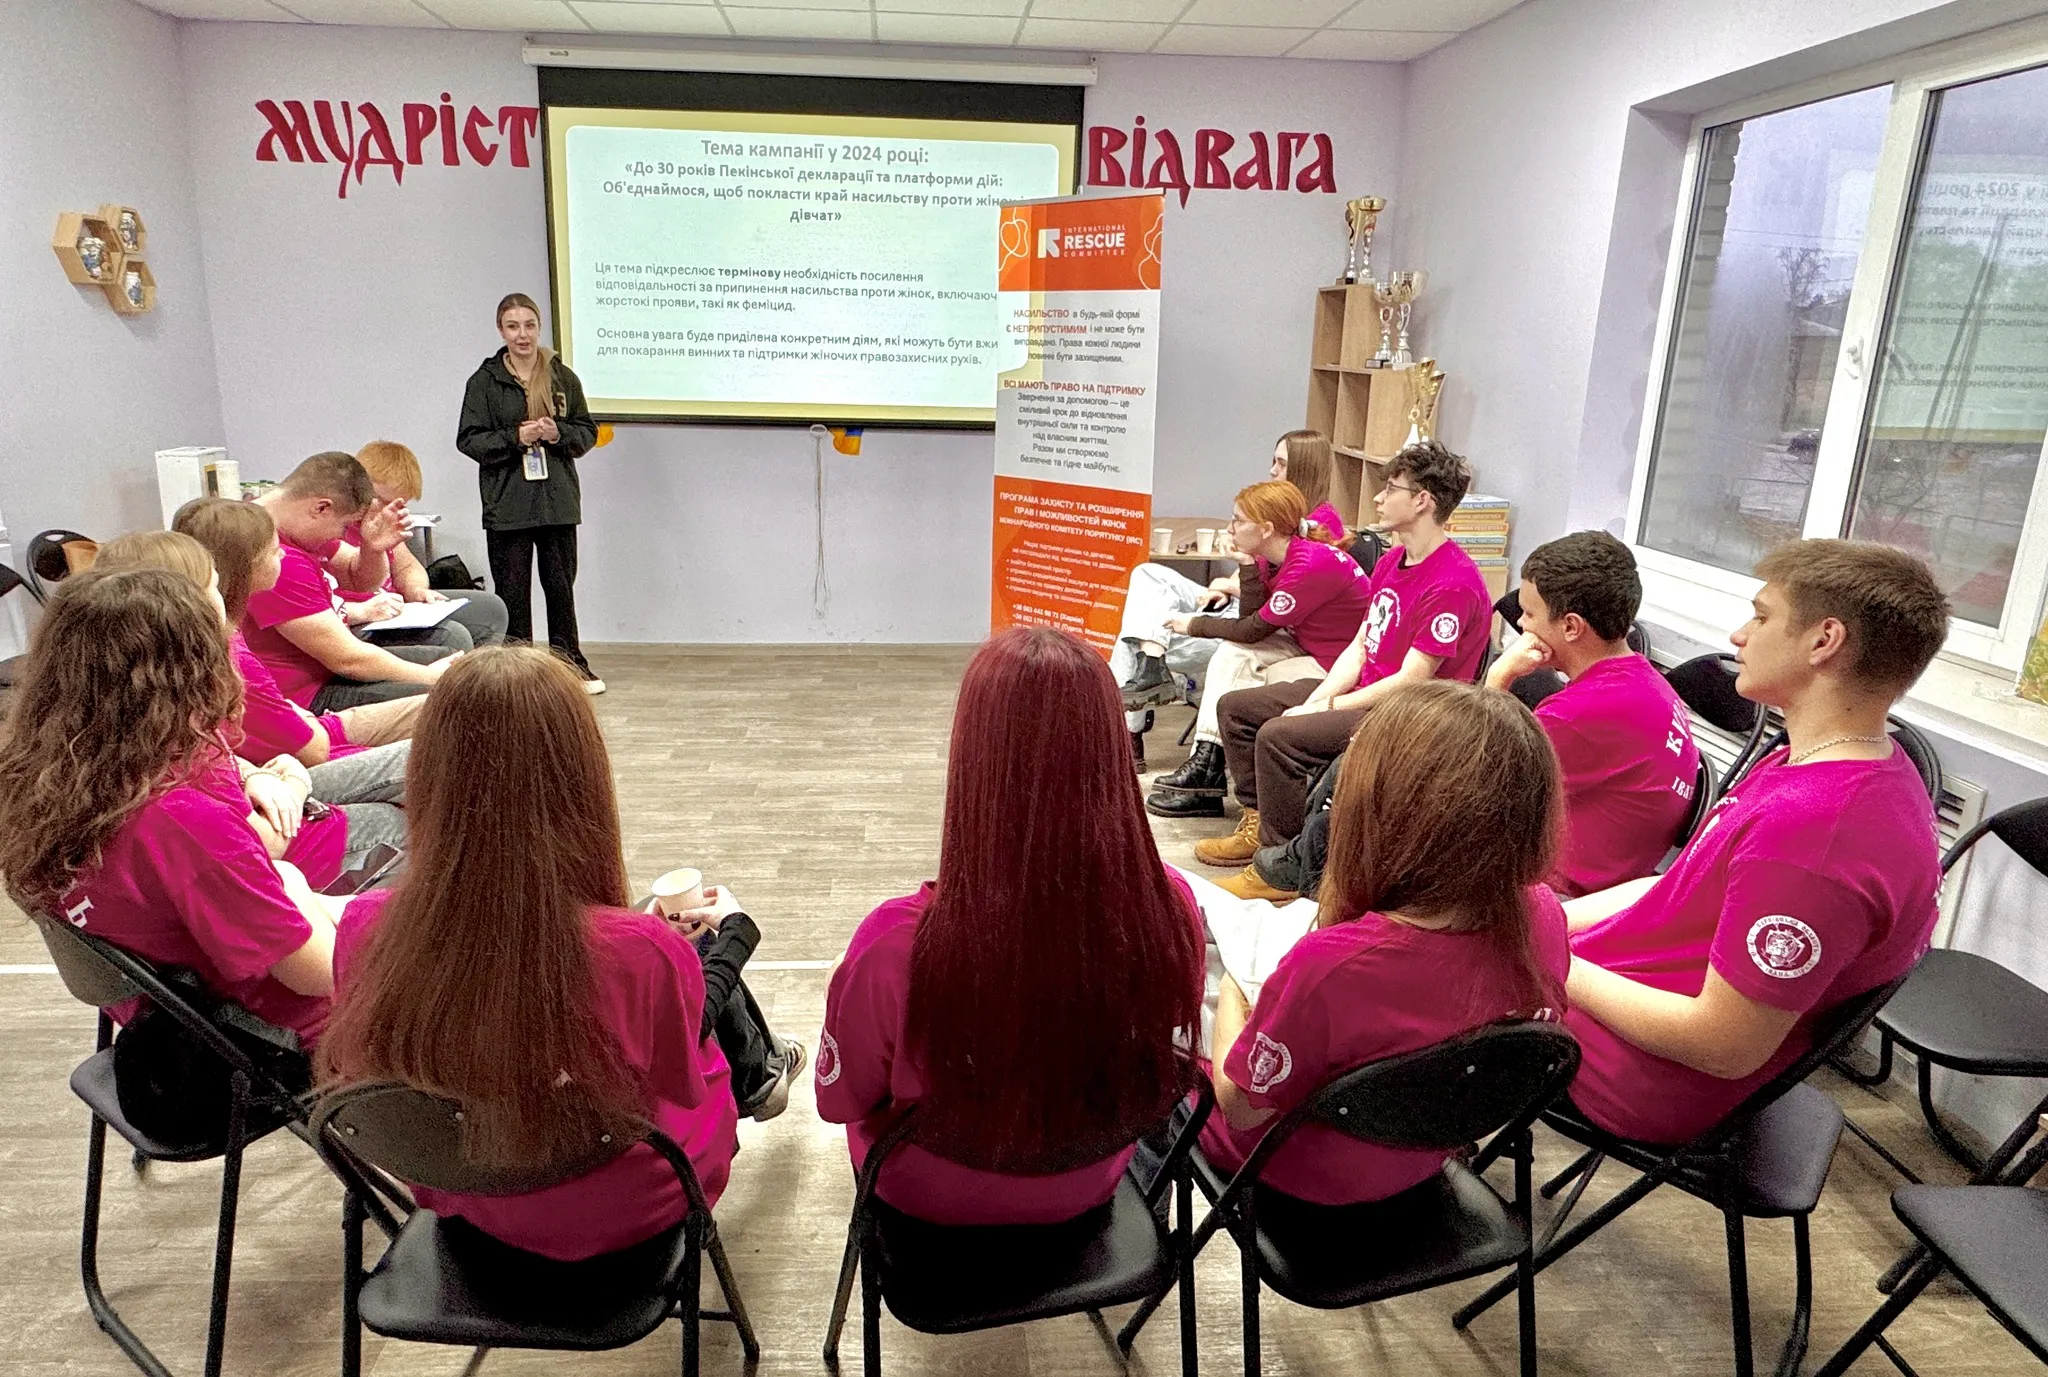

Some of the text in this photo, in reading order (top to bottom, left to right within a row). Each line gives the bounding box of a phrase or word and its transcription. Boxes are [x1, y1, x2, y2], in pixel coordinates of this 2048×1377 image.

[255, 92, 540, 199] МУДРІСТ
[701, 140, 929, 165] Тема кампанії у 2024 році:
[1087, 115, 1337, 210] ВІДВАГА
[625, 162, 1003, 188] «До 30 років Пекінської декларації та платформи дій:
[603, 181, 709, 199] Об'єднаймося,
[714, 185, 743, 200] щоб
[748, 189, 810, 201] покласти
[815, 189, 848, 203] край
[852, 192, 928, 206] насильству
[932, 195, 972, 207] проти
[790, 208, 842, 223] дівчат»
[1064, 224, 1126, 233] INTERNATIONAL
[1064, 232, 1126, 249] RESCUE
[1064, 249, 1126, 258] COMMITTEE
[595, 262, 924, 282] Ця тема підкреслює термінову необхідність посилення
[596, 279, 696, 292] відповідальності
[699, 283, 713, 292] за
[715, 284, 788, 295] припинення
[791, 286, 858, 296] насильства
[861, 289, 895, 299] проти
[898, 289, 935, 300] жінок,
[596, 296, 796, 312] жорстокі прояви, такі як феміцид.
[1013, 309, 1070, 318] НАСИЛЬСТВО
[1013, 324, 1087, 334] НЕПРИПУСТИМИМ
[1127, 324, 1145, 336] бути
[597, 328, 649, 340] Основна
[652, 331, 684, 342] увага
[687, 330, 714, 343] буде
[717, 331, 778, 344] приділена
[781, 334, 850, 345] конкретним
[852, 334, 882, 347] діям,
[885, 335, 900, 346] які
[903, 338, 945, 349] можуть
[948, 337, 973, 349] бути
[1059, 338, 1082, 348] Права
[597, 346, 982, 366] для покарання винних та підтримки жіночих правозахисних рухів.
[1056, 351, 1073, 362] бути
[1018, 381, 1049, 390] МАЮТЬ
[1051, 382, 1080, 391] ПРАВО
[1082, 384, 1095, 393] НА
[1097, 384, 1146, 396] ПІДТРИМКУ
[1014, 506, 1034, 517] ПРАВ
[1040, 497, 1075, 510] ЗАХИСТУ
[1076, 502, 1086, 511] ТА
